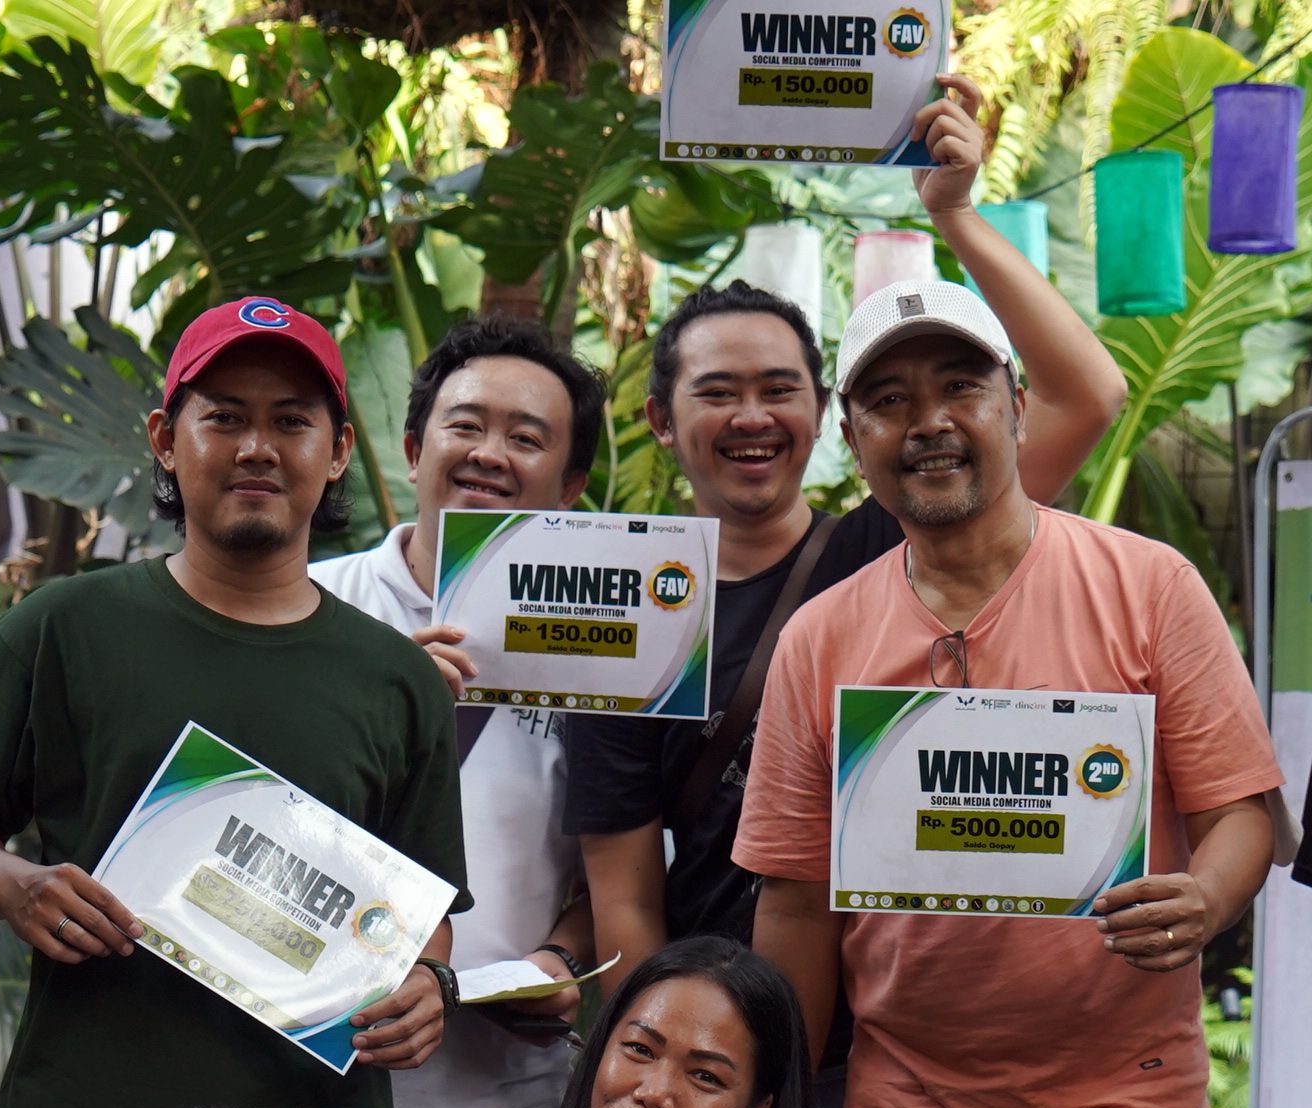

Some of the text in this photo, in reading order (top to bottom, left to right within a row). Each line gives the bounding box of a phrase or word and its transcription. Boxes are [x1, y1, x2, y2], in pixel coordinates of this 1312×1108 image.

[741, 12, 876, 56] WINNER
[891, 24, 924, 45] FAV
[752, 55, 861, 67] SOCIAL MEDIA COMPETITION
[743, 73, 869, 96] Rp. 150.000
[509, 564, 641, 607] WINNER
[657, 576, 688, 597] FAV
[518, 604, 626, 618] SOCIAL MEDIA COMPETITION
[509, 621, 633, 645] Rp. 150.000
[918, 749, 1068, 796] WINNER
[1088, 761, 1119, 783] 2ND
[930, 795, 1052, 809] SOCIAL MEDIA COMPETITION
[921, 816, 1059, 839] Rp. 500.000
[963, 841, 1016, 851] Saldo Gopay
[215, 815, 355, 930] WINNER
[217, 860, 322, 932] SOCIAL MEDIA COMPETITION
